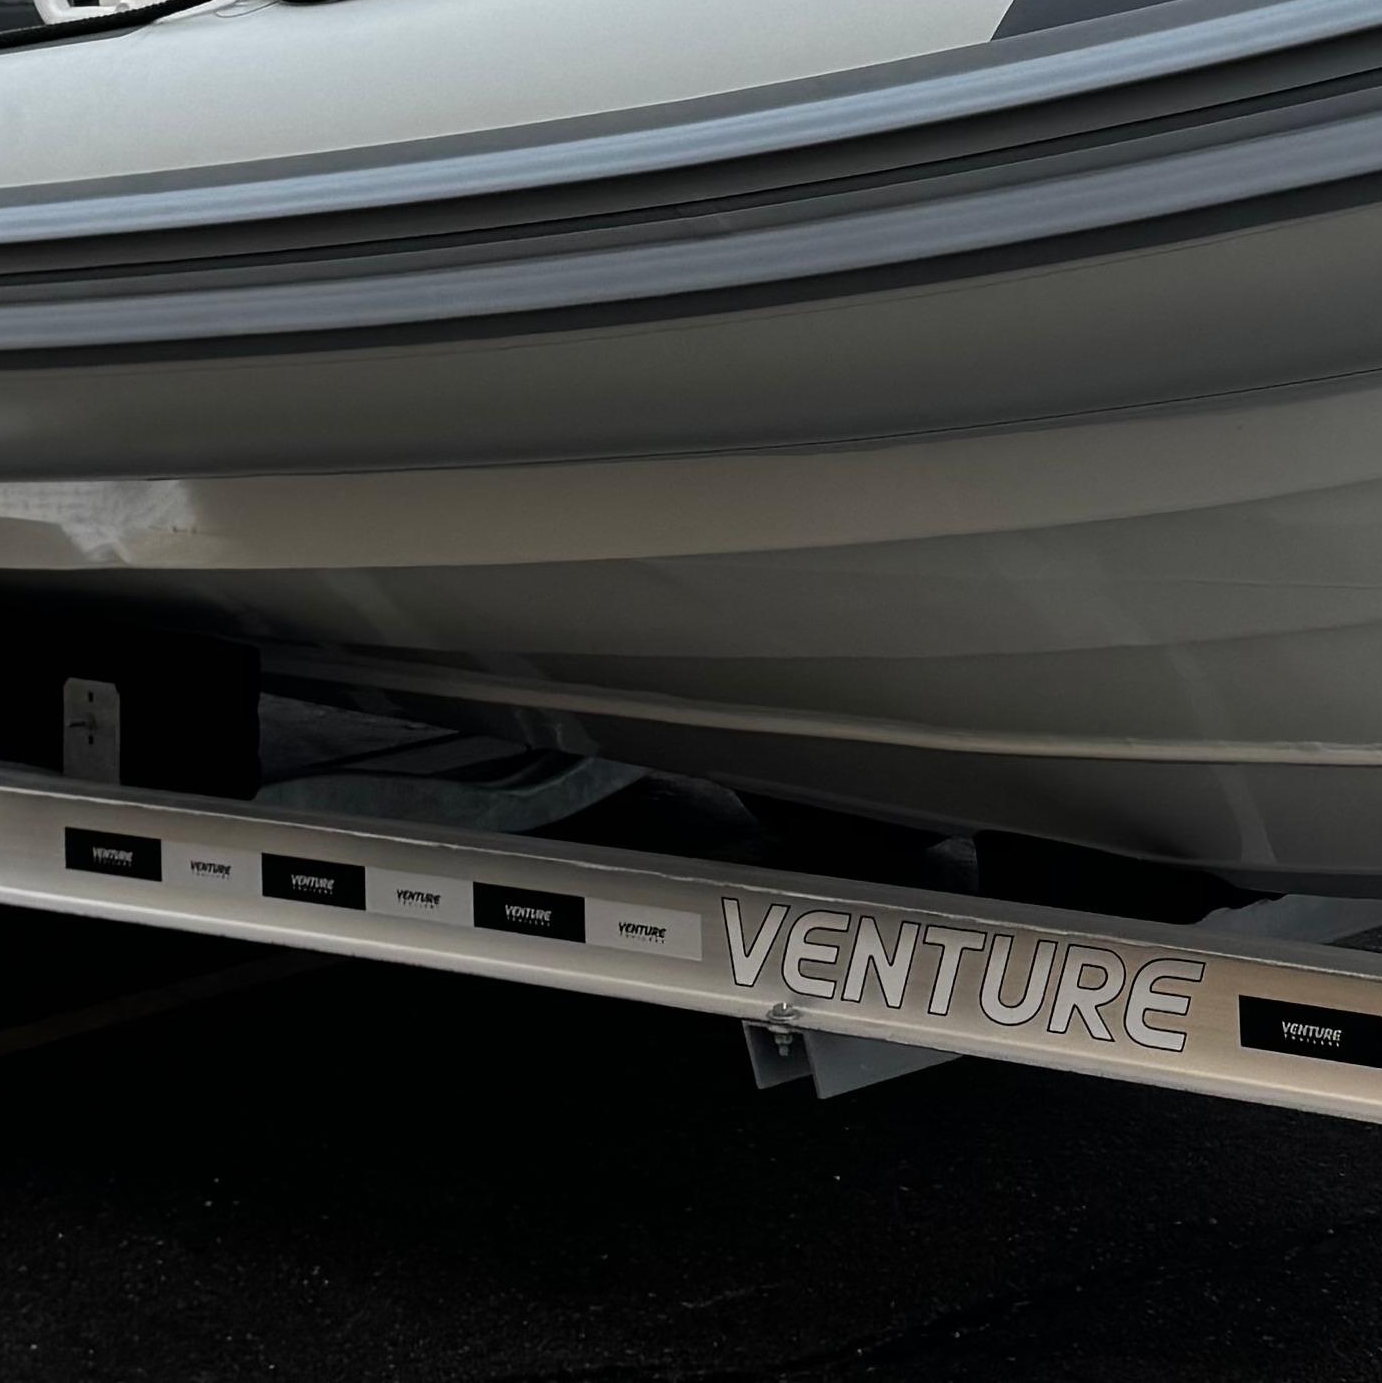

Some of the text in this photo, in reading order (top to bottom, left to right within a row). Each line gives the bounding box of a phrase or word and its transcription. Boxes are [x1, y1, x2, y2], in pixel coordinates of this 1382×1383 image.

[190, 861, 232, 875] VENTURE
[396, 889, 441, 905] VENTURE
[618, 922, 667, 938] VENTURE
[721, 897, 1205, 1052] VENTURE
[1282, 1021, 1342, 1041] VENTURE
